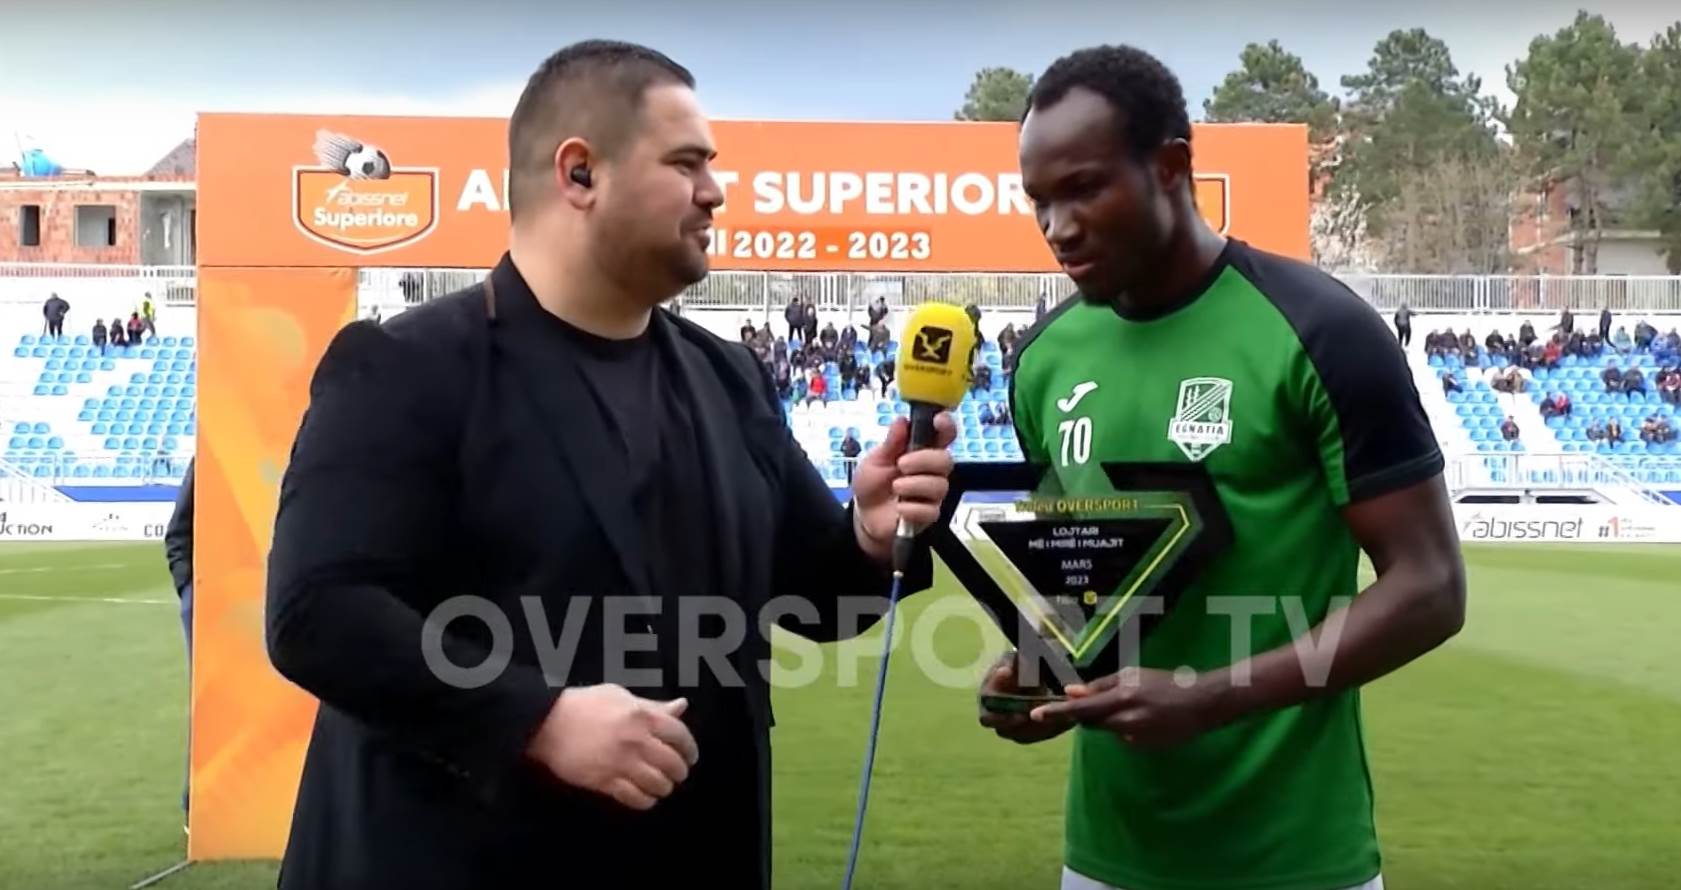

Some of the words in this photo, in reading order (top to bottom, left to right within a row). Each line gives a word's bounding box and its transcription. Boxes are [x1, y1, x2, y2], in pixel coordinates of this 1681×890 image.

[313, 207, 419, 230] Superiore
[733, 230, 817, 259] 2022
[848, 231, 931, 260] 2023
[1175, 423, 1224, 435] EGNATIA
[1057, 417, 1093, 467] 70
[1056, 498, 1139, 513] OVERSPORT
[1052, 526, 1100, 537] LOJTARI
[1472, 517, 1584, 539] abissnet
[1060, 558, 1093, 571] MARS
[1064, 575, 1090, 586] 2023
